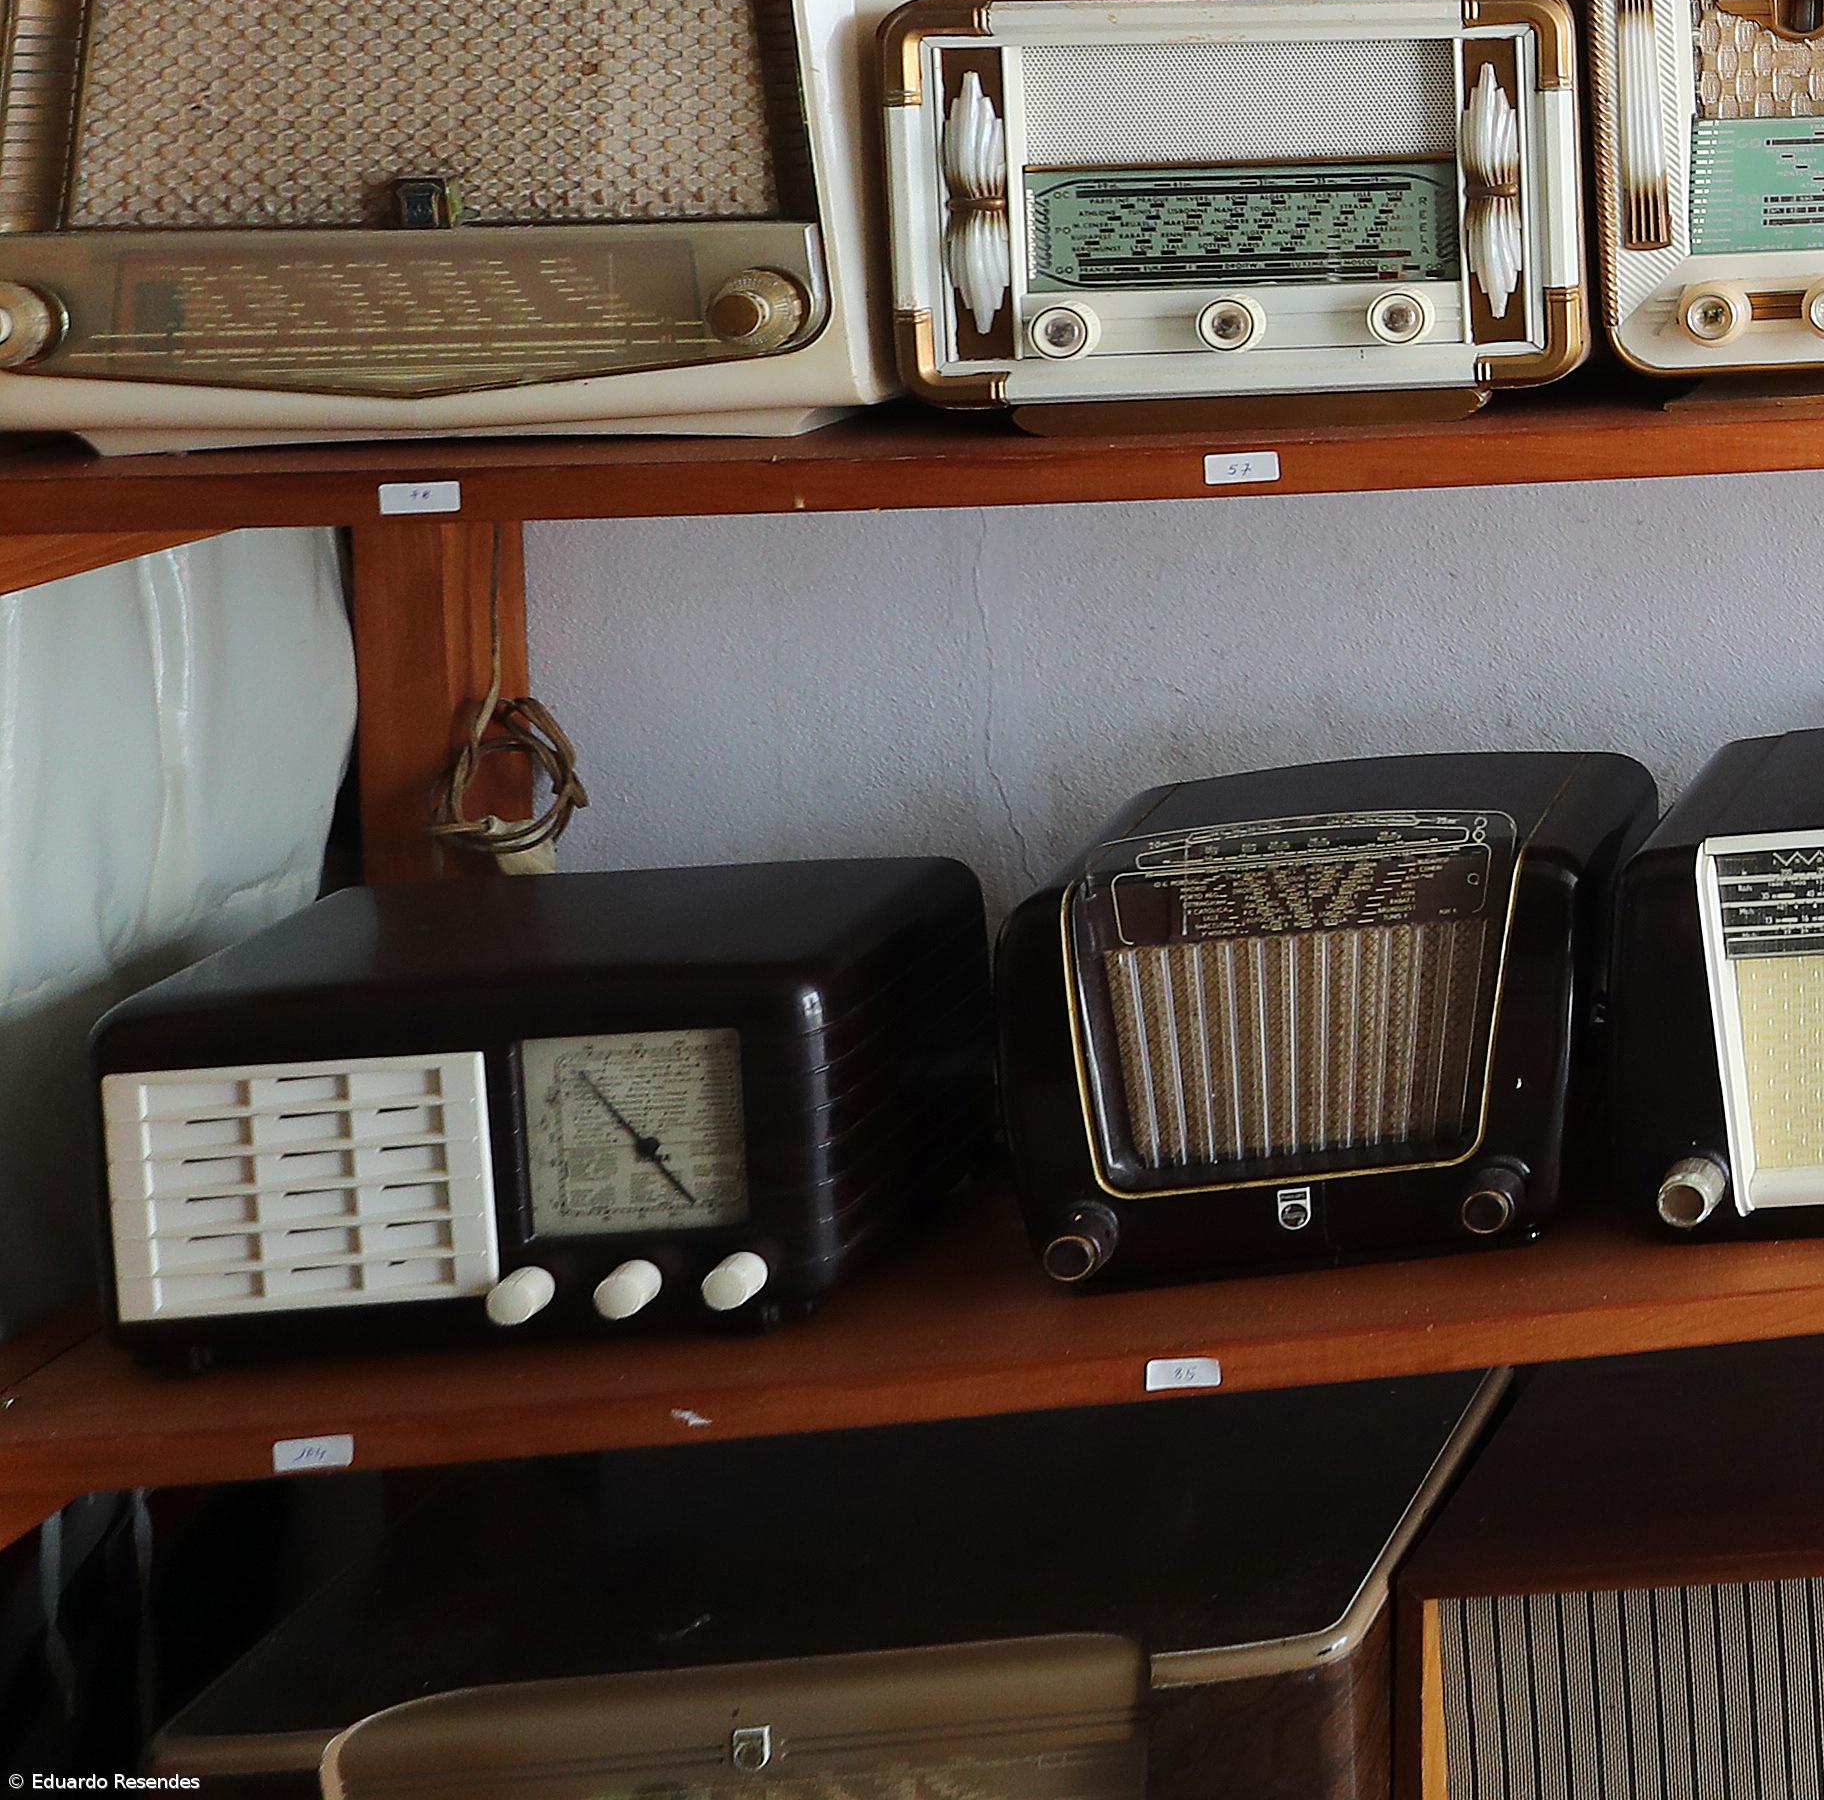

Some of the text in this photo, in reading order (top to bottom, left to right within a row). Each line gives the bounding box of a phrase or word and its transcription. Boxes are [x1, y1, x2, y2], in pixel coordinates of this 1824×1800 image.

[1053, 191, 1070, 199] OC
[1055, 266, 1073, 274] GO
[1228, 462, 1253, 476] 57
